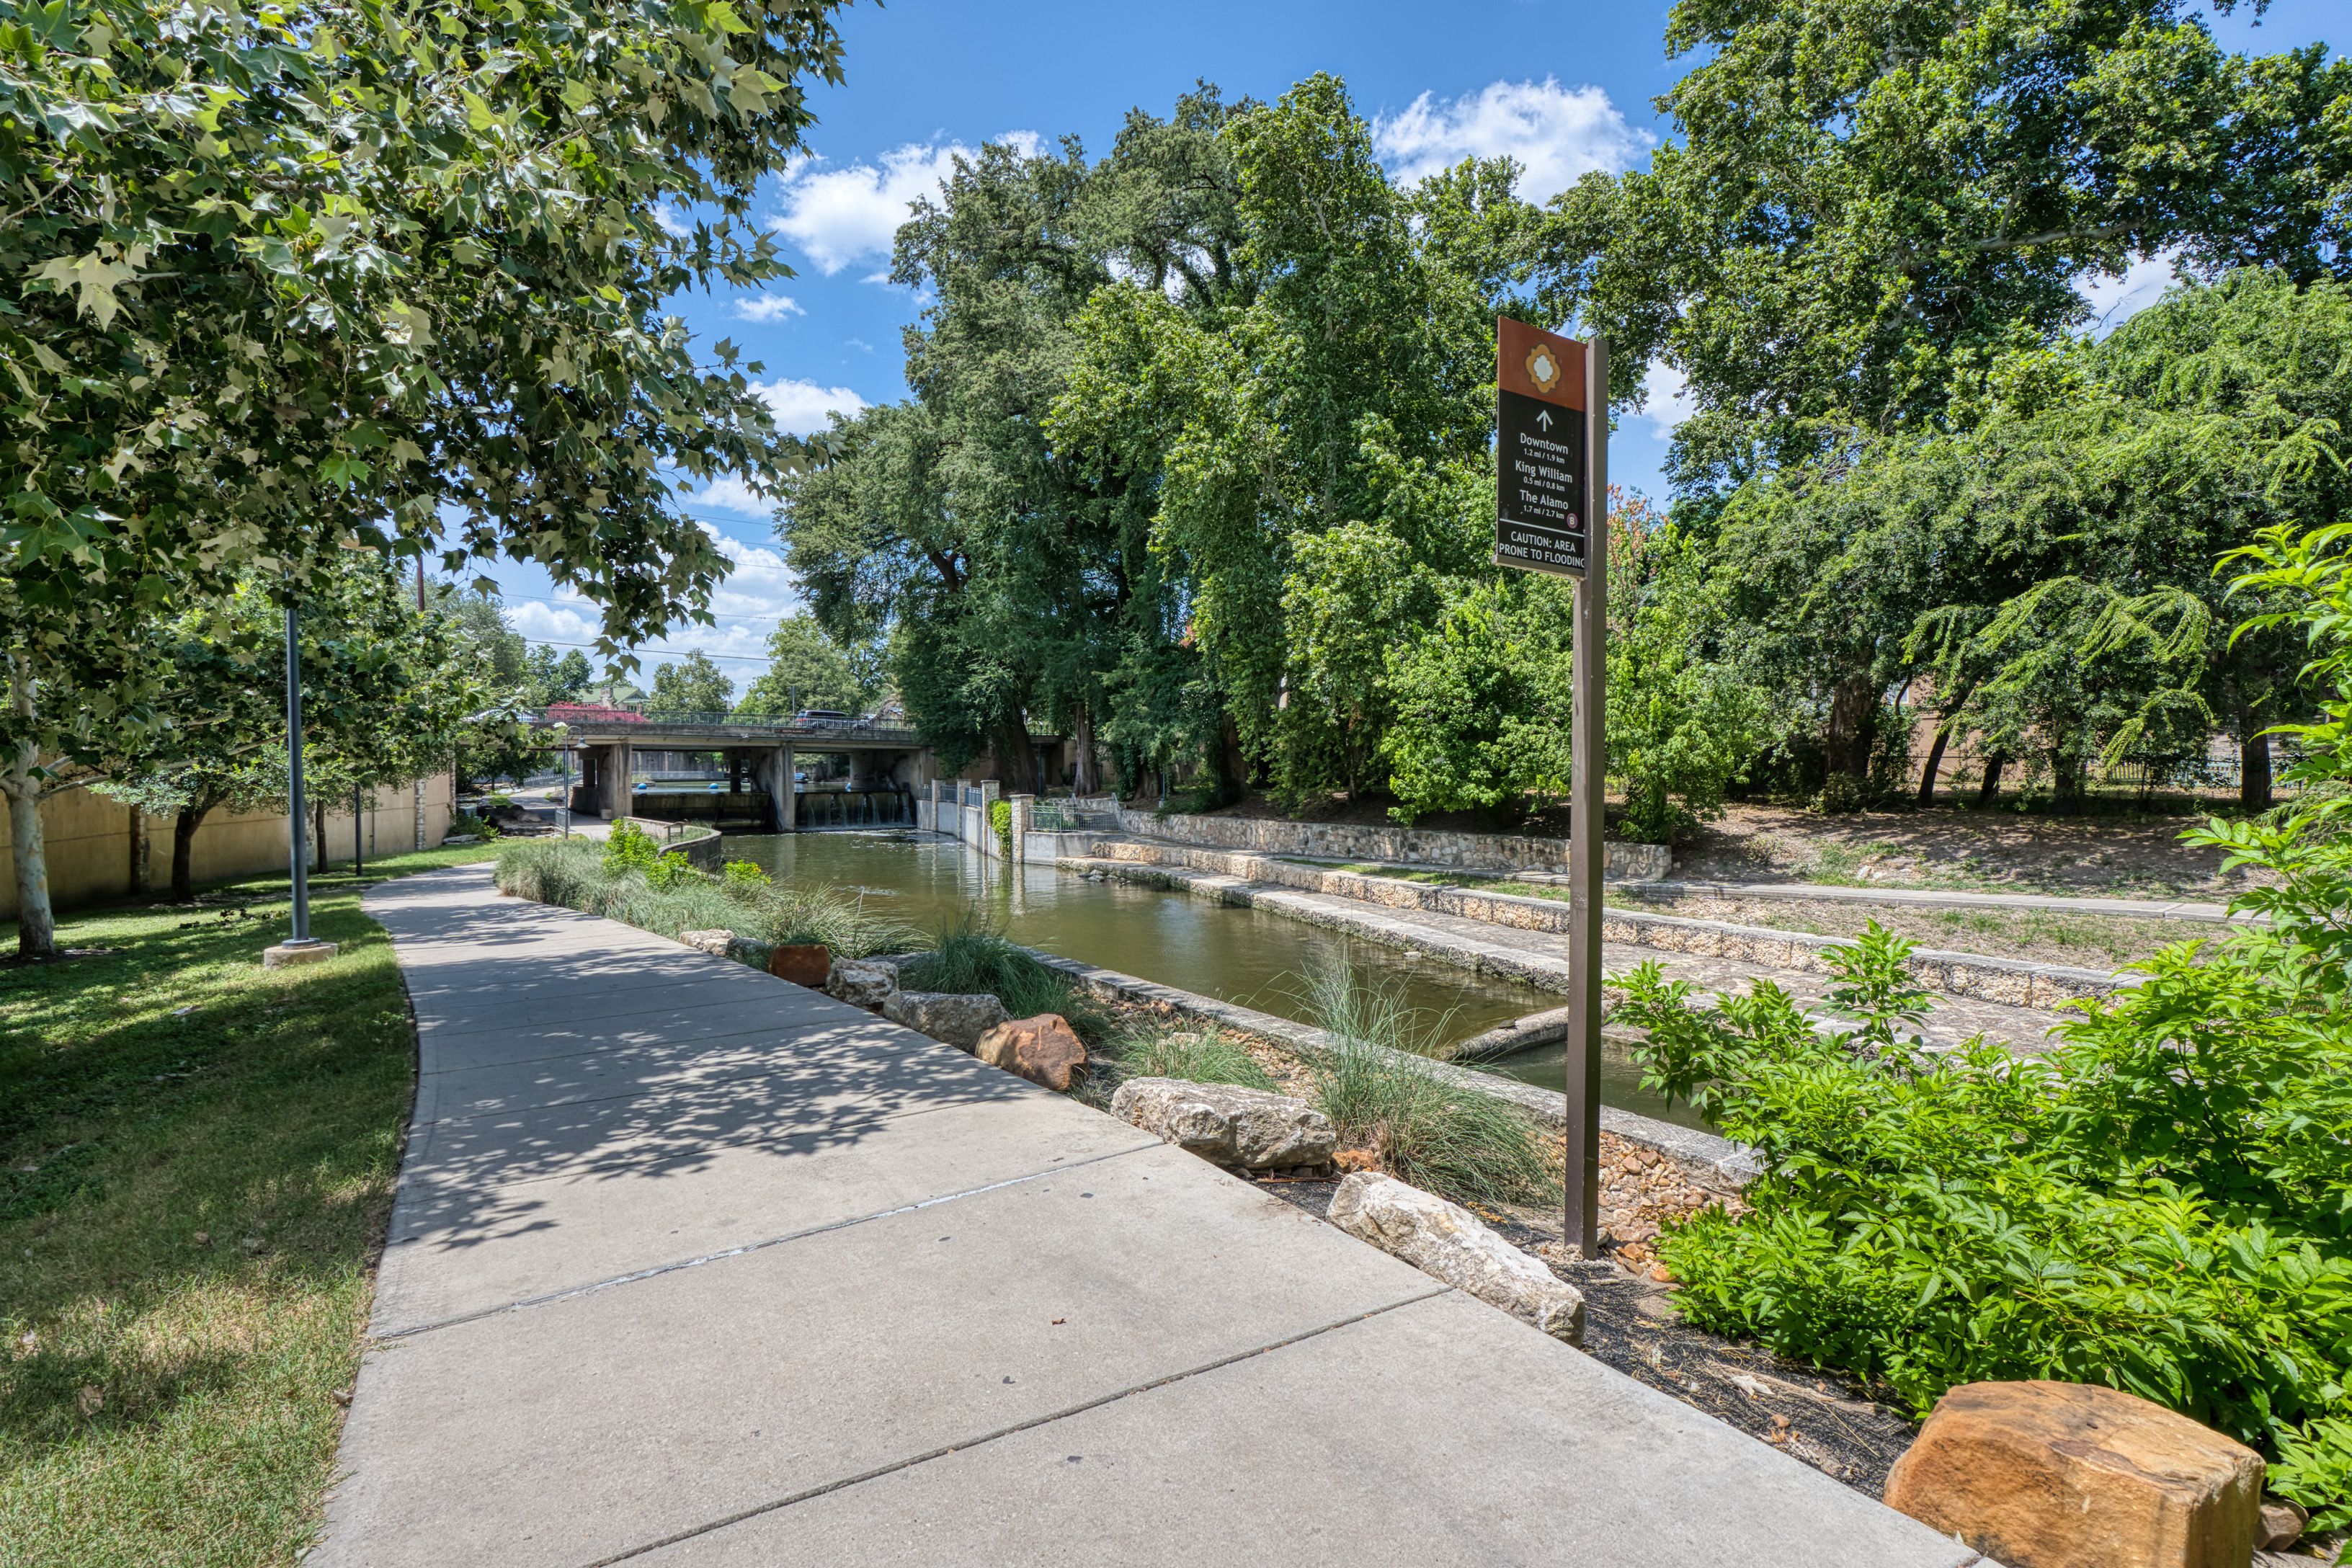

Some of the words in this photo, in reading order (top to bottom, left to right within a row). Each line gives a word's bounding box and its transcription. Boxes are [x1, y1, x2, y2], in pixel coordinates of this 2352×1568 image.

[1520, 432, 1569, 455] Downtown
[1524, 447, 1533, 457] 1.2
[1556, 455, 1565, 464] km
[1515, 460, 1536, 477] King
[1538, 465, 1573, 484] William
[1523, 476, 1533, 485] 0.5
[1533, 478, 1541, 487] mi
[1546, 481, 1556, 490] 0.8
[1556, 484, 1565, 492] km
[1519, 489, 1538, 503] The
[1540, 494, 1569, 510] Alamo
[1523, 504, 1533, 513] 1.7
[1546, 509, 1556, 517] 2.7
[1556, 511, 1565, 520] km
[1499, 543, 1528, 558] PRONE
[1530, 548, 1542, 560] TO
[1510, 531, 1552, 548] CAUTION:
[1554, 539, 1576, 553] AREA
